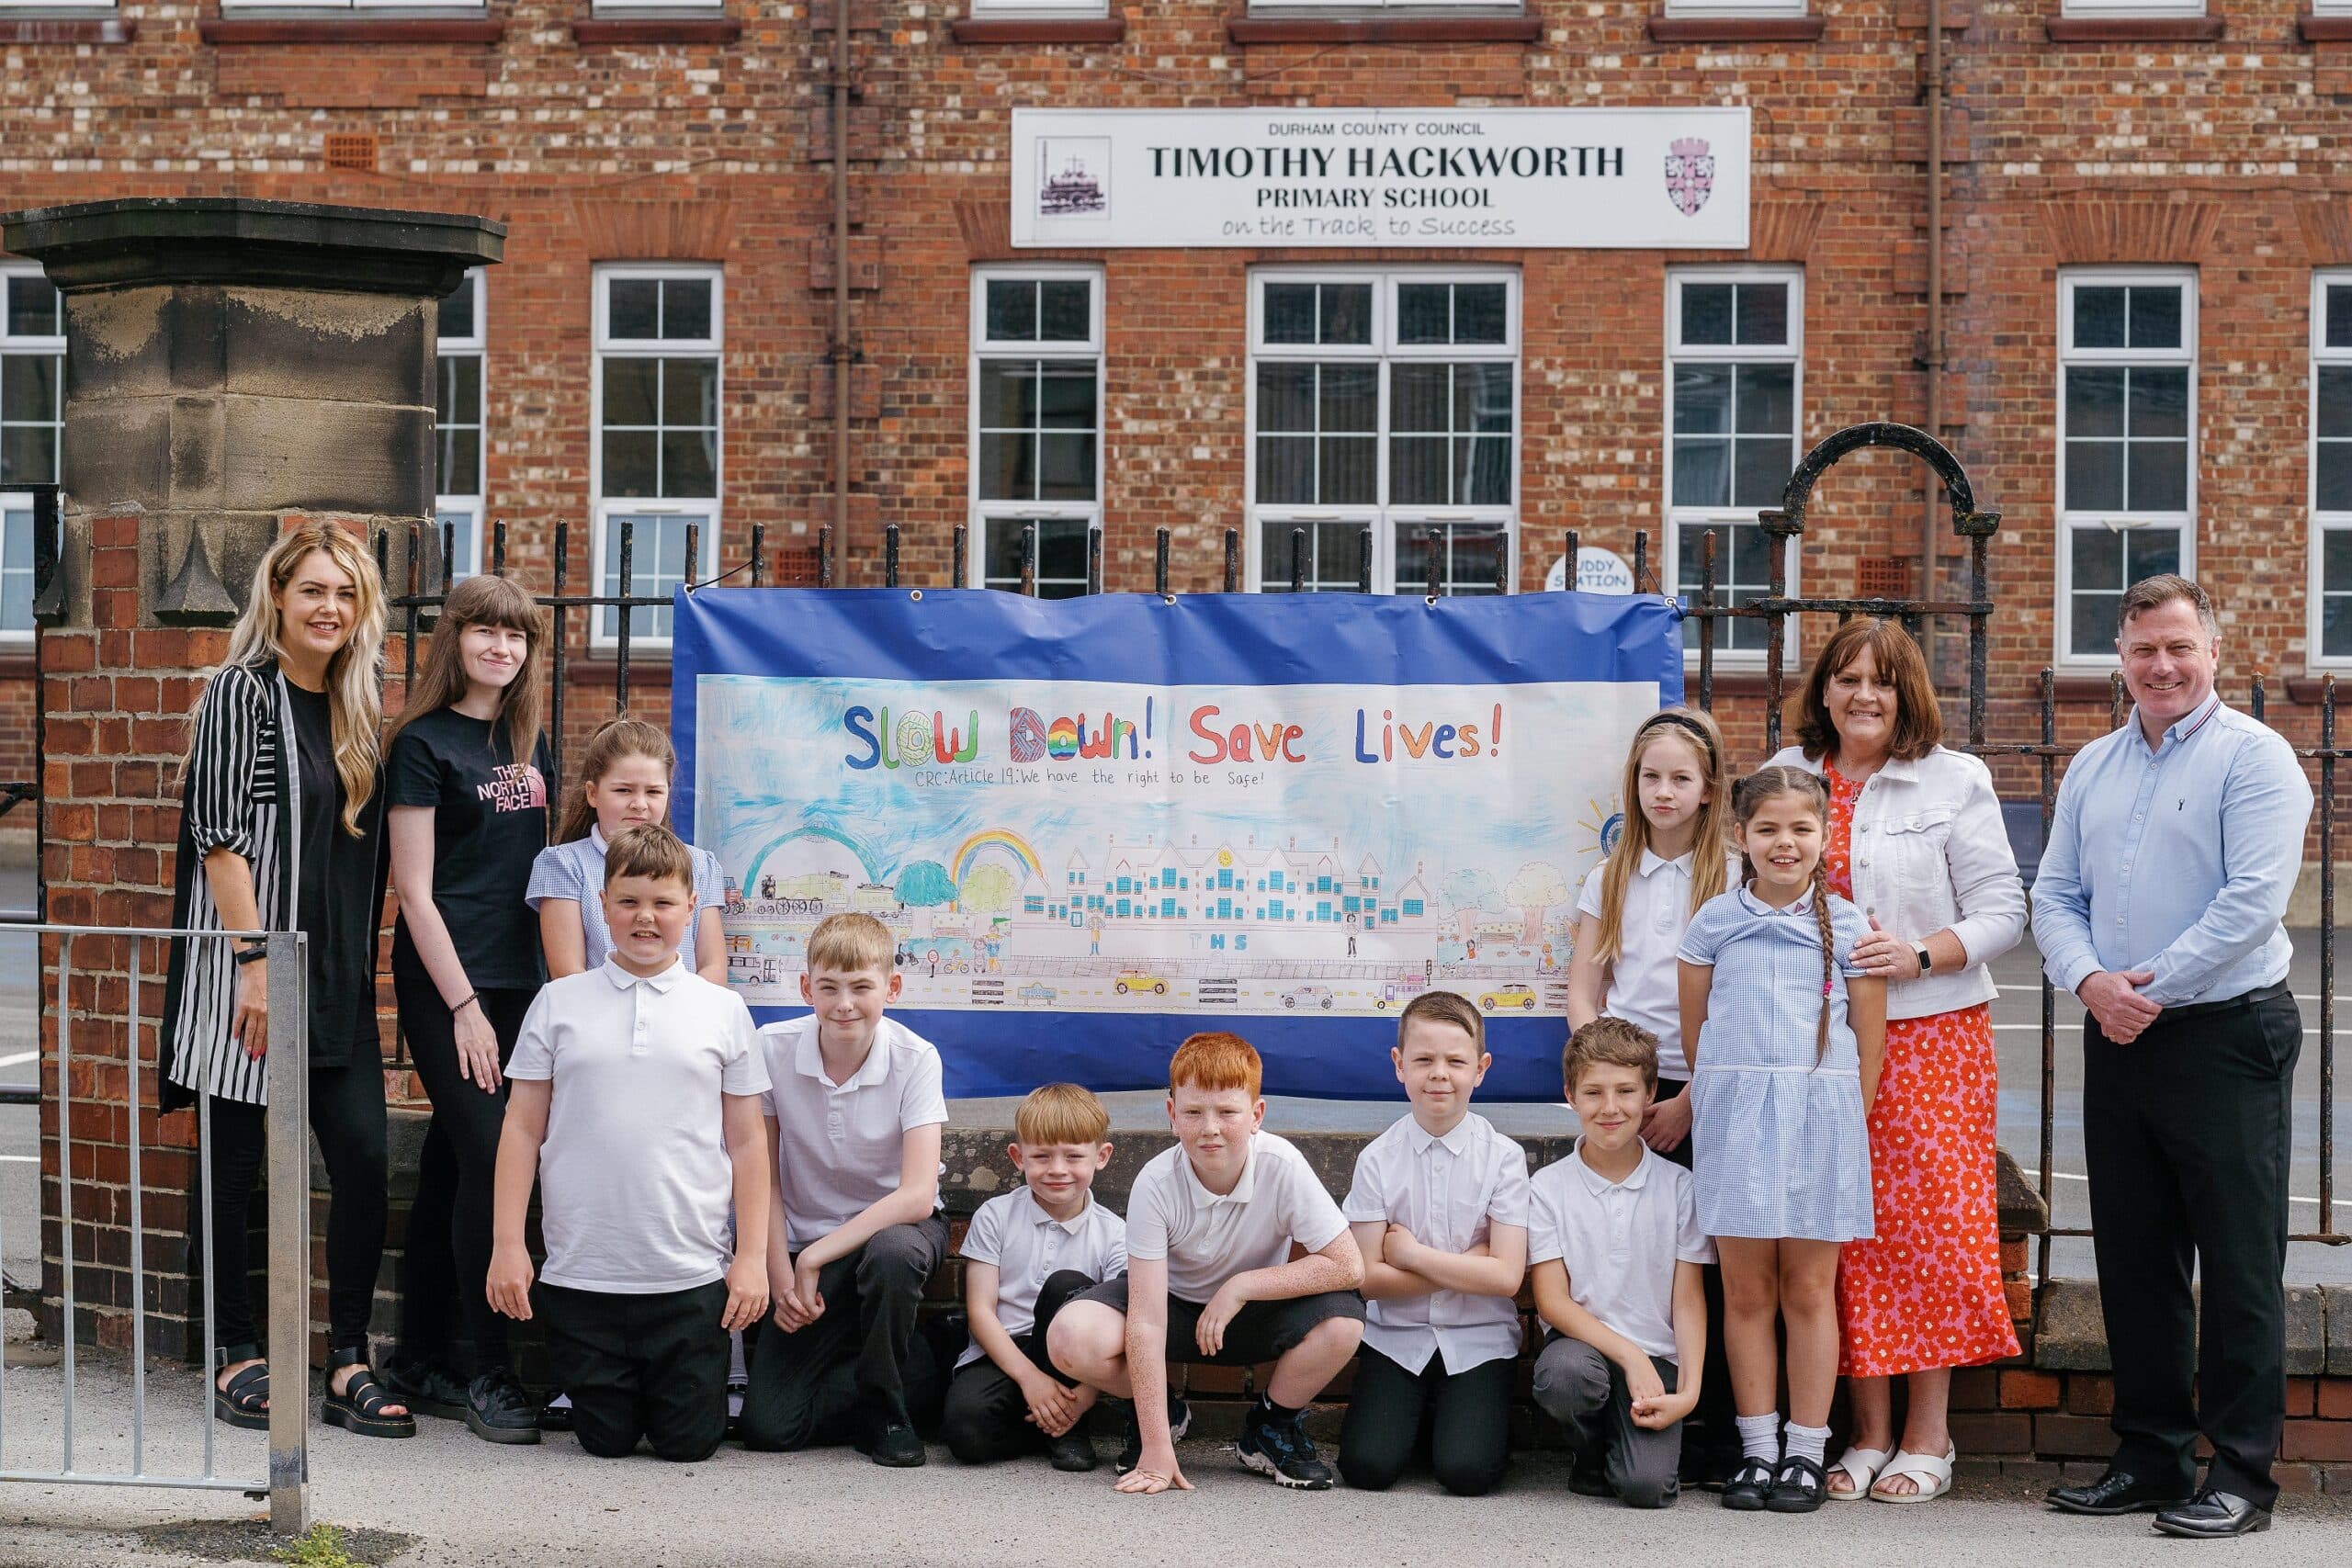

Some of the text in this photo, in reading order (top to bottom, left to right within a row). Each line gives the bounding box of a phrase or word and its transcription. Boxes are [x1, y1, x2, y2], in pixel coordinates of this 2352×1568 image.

[1268, 122, 1485, 136] DURHAM COUNTY COUNCIL
[1147, 146, 1623, 177] TIMOTHY HACKWORTH
[1256, 186, 1496, 208] PRIMARY SCHOOL
[1222, 214, 1516, 236] on the Track to Success
[1555, 575, 1626, 586] SATION
[1189, 705, 1306, 764] Save
[1355, 703, 1501, 763] Lives!
[1046, 767, 1078, 784] have
[1091, 768, 1115, 784] the
[1127, 770, 1159, 788] right
[1170, 771, 1184, 784] to
[1193, 770, 1211, 784] be
[477, 778, 528, 800] NORTH
[496, 795, 530, 813] FACE
